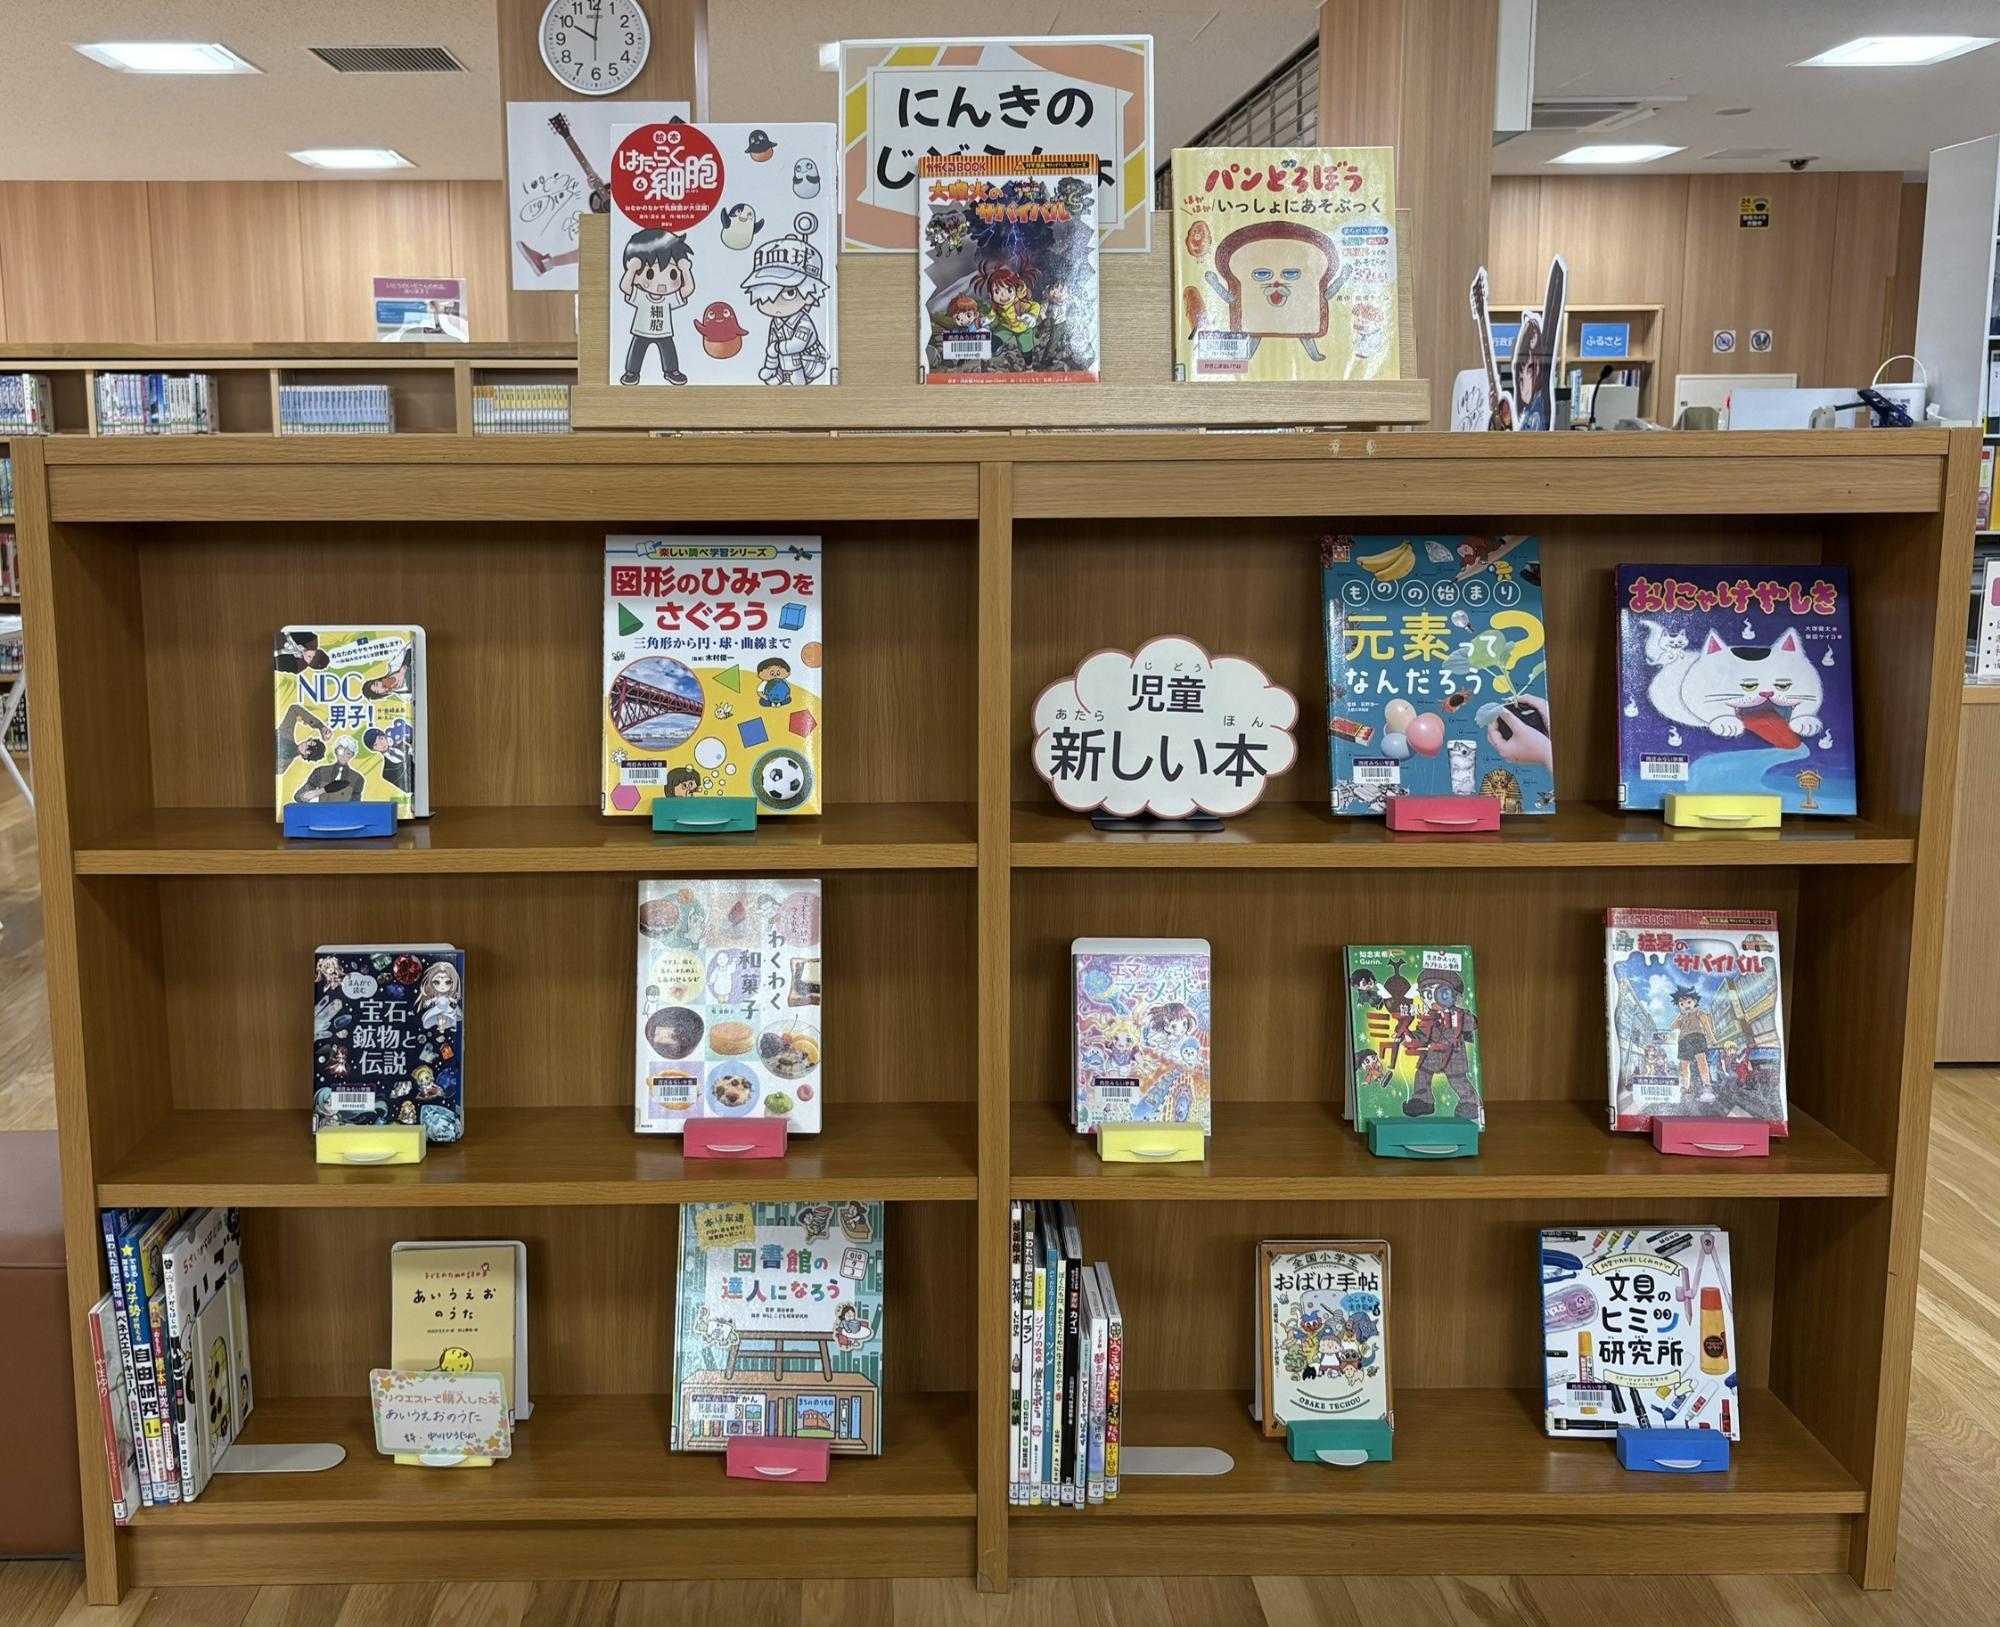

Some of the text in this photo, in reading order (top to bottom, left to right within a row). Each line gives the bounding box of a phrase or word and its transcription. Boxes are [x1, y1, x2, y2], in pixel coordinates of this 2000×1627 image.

[572, 2, 582, 15] 11
[609, 2, 615, 15] 1
[560, 15, 574, 28] 10
[620, 15, 629, 28] 2
[556, 32, 566, 45] 9
[625, 32, 634, 45] 3
[561, 50, 571, 63] 8
[620, 50, 630, 63] 4
[574, 63, 584, 76] 7
[591, 67, 601, 80] 6
[609, 63, 618, 76] 5
[898, 84, 1094, 129] にんきの
[619, 145, 686, 174] はたらく
[644, 153, 718, 200] 細胞
[1204, 159, 1364, 193] パンどろぼう
[976, 202, 1073, 224] サバイバル
[1218, 198, 1382, 215] いっしょにあそぶっく
[1586, 335, 1623, 347] ふるさと
[659, 547, 767, 558] 楽しい調べ学習シリーズ
[611, 565, 814, 597] 図形のひみつを
[1346, 579, 1516, 602] ものの始まり
[655, 601, 769, 631] さぐろう
[633, 637, 792, 650] 三角形から円・球・曲線まで
[1144, 661, 1202, 672] じどう
[298, 673, 364, 704] NDC
[1345, 667, 1483, 695] なんだろう
[1128, 674, 1206, 713] 児童
[329, 705, 375, 729] 男子！
[1055, 708, 1105, 722] あたら
[1223, 715, 1264, 728] ほん
[1049, 726, 1268, 787] 新しい本
[767, 930, 787, 1011] わくわく
[1673, 953, 1766, 976] サバイバル
[738, 949, 762, 1020] 和菓子
[352, 1024, 417, 1050] 鉱物と
[358, 1050, 408, 1076] 伝説
[733, 1243, 829, 1274] 図書館の
[1292, 1252, 1359, 1270] 全国小学生
[720, 1276, 841, 1303] 達人になろう
[1273, 1271, 1379, 1292] おばけ手帖
[1605, 1272, 1672, 1303] 文具の
[413, 1287, 497, 1304] あいうえお
[434, 1306, 474, 1320] のうた
[1070, 1310, 1078, 1334] カイコ
[1602, 1306, 1680, 1334] ヒミツ
[1023, 1315, 1033, 1344] イラン
[1598, 1338, 1684, 1366] 研究所
[135, 1348, 159, 1417] 自由研究
[1299, 1396, 1362, 1410] OBAKE TECHOU
[385, 1409, 483, 1424] あいうえおのうた
